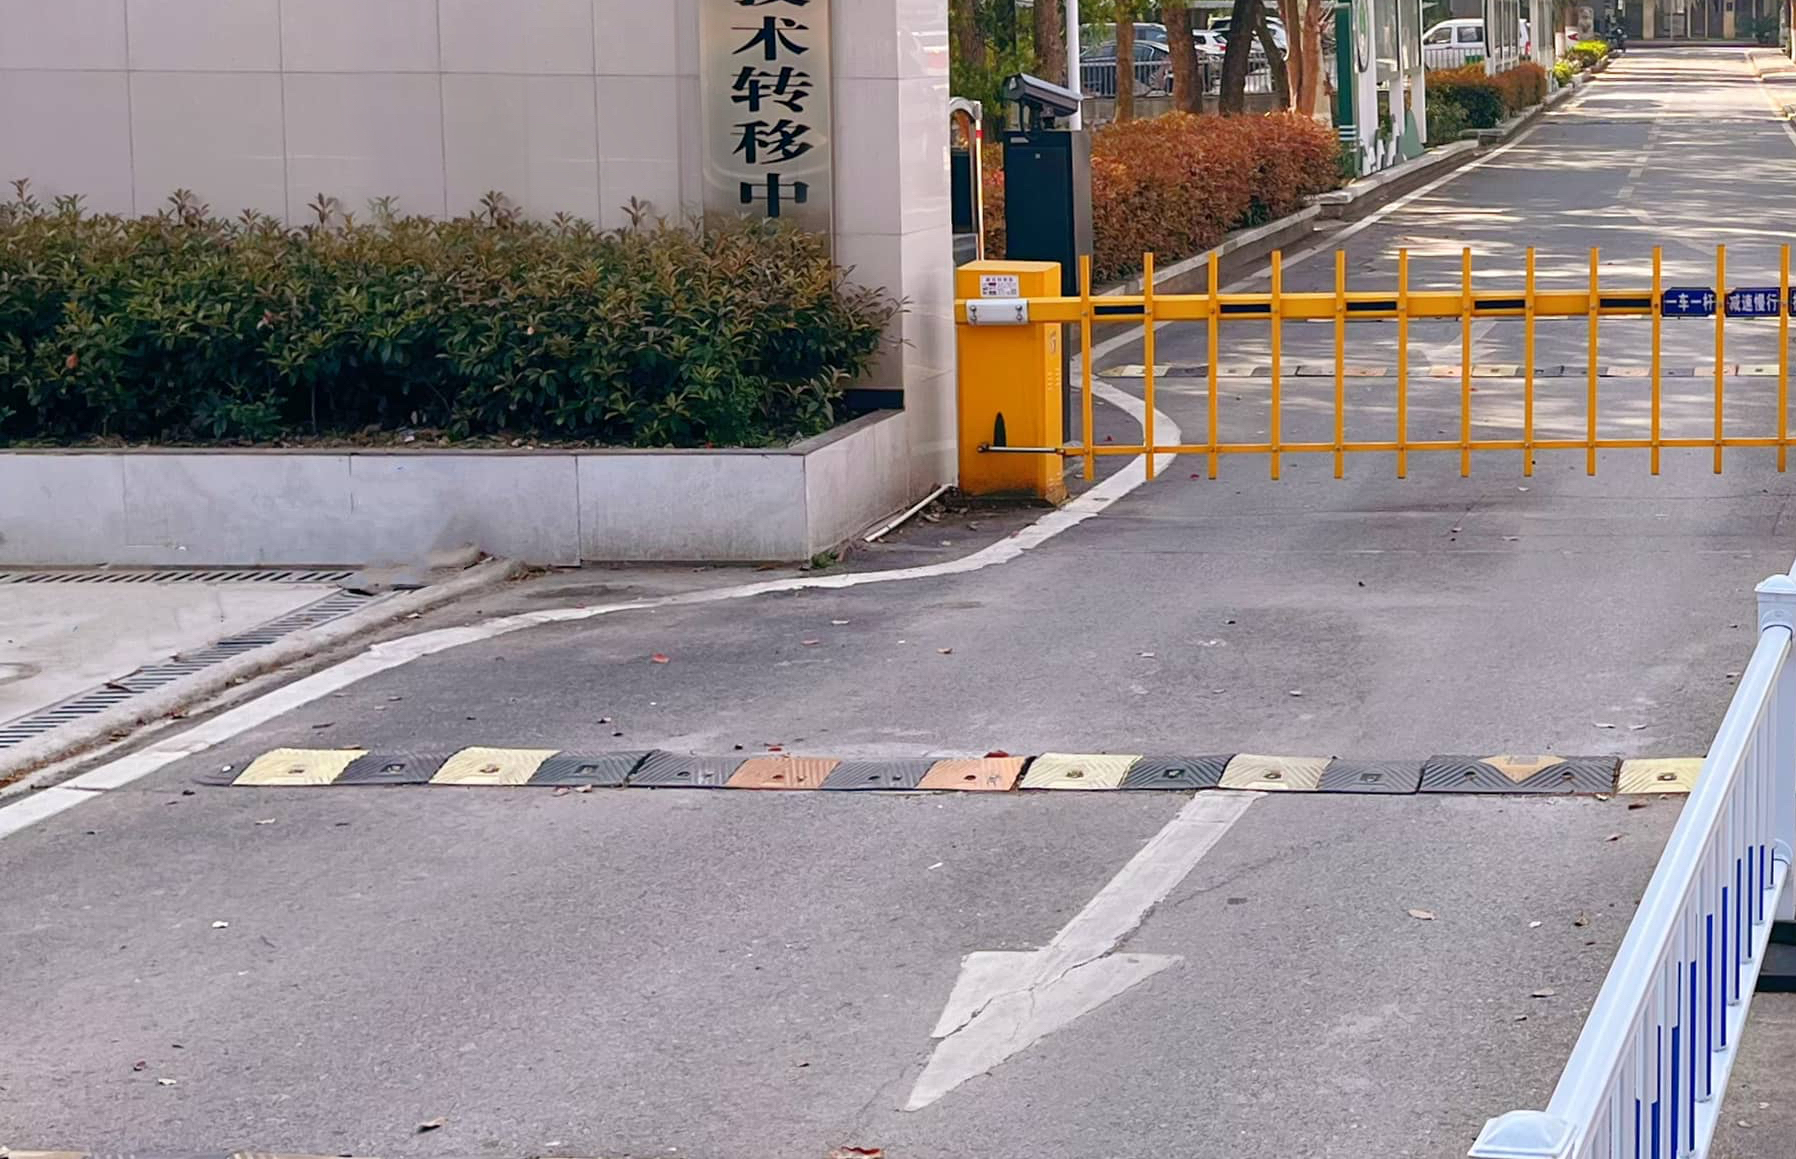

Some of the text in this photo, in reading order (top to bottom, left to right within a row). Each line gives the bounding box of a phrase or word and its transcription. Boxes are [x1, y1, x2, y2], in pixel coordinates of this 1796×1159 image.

[1664, 293, 1715, 312] 一车一杆
[1729, 293, 1779, 312] 减速慢行
